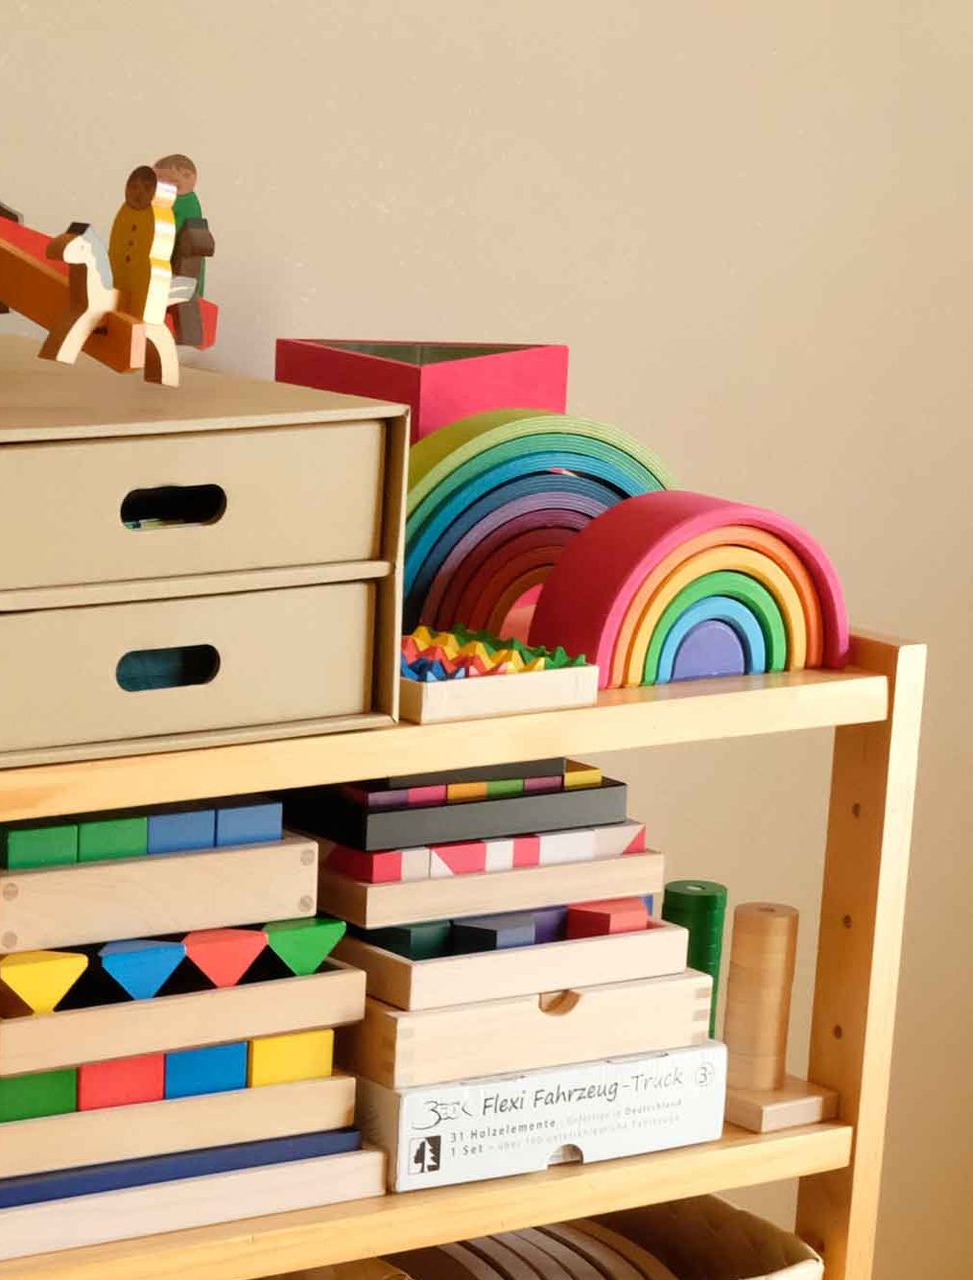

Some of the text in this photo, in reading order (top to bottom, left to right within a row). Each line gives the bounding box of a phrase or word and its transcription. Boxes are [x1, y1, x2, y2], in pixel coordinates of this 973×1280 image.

[482, 1089, 526, 1116] Flexi
[451, 1131, 464, 1144] 31
[471, 1119, 556, 1140] Holzelemente
[462, 1144, 484, 1157] Set
